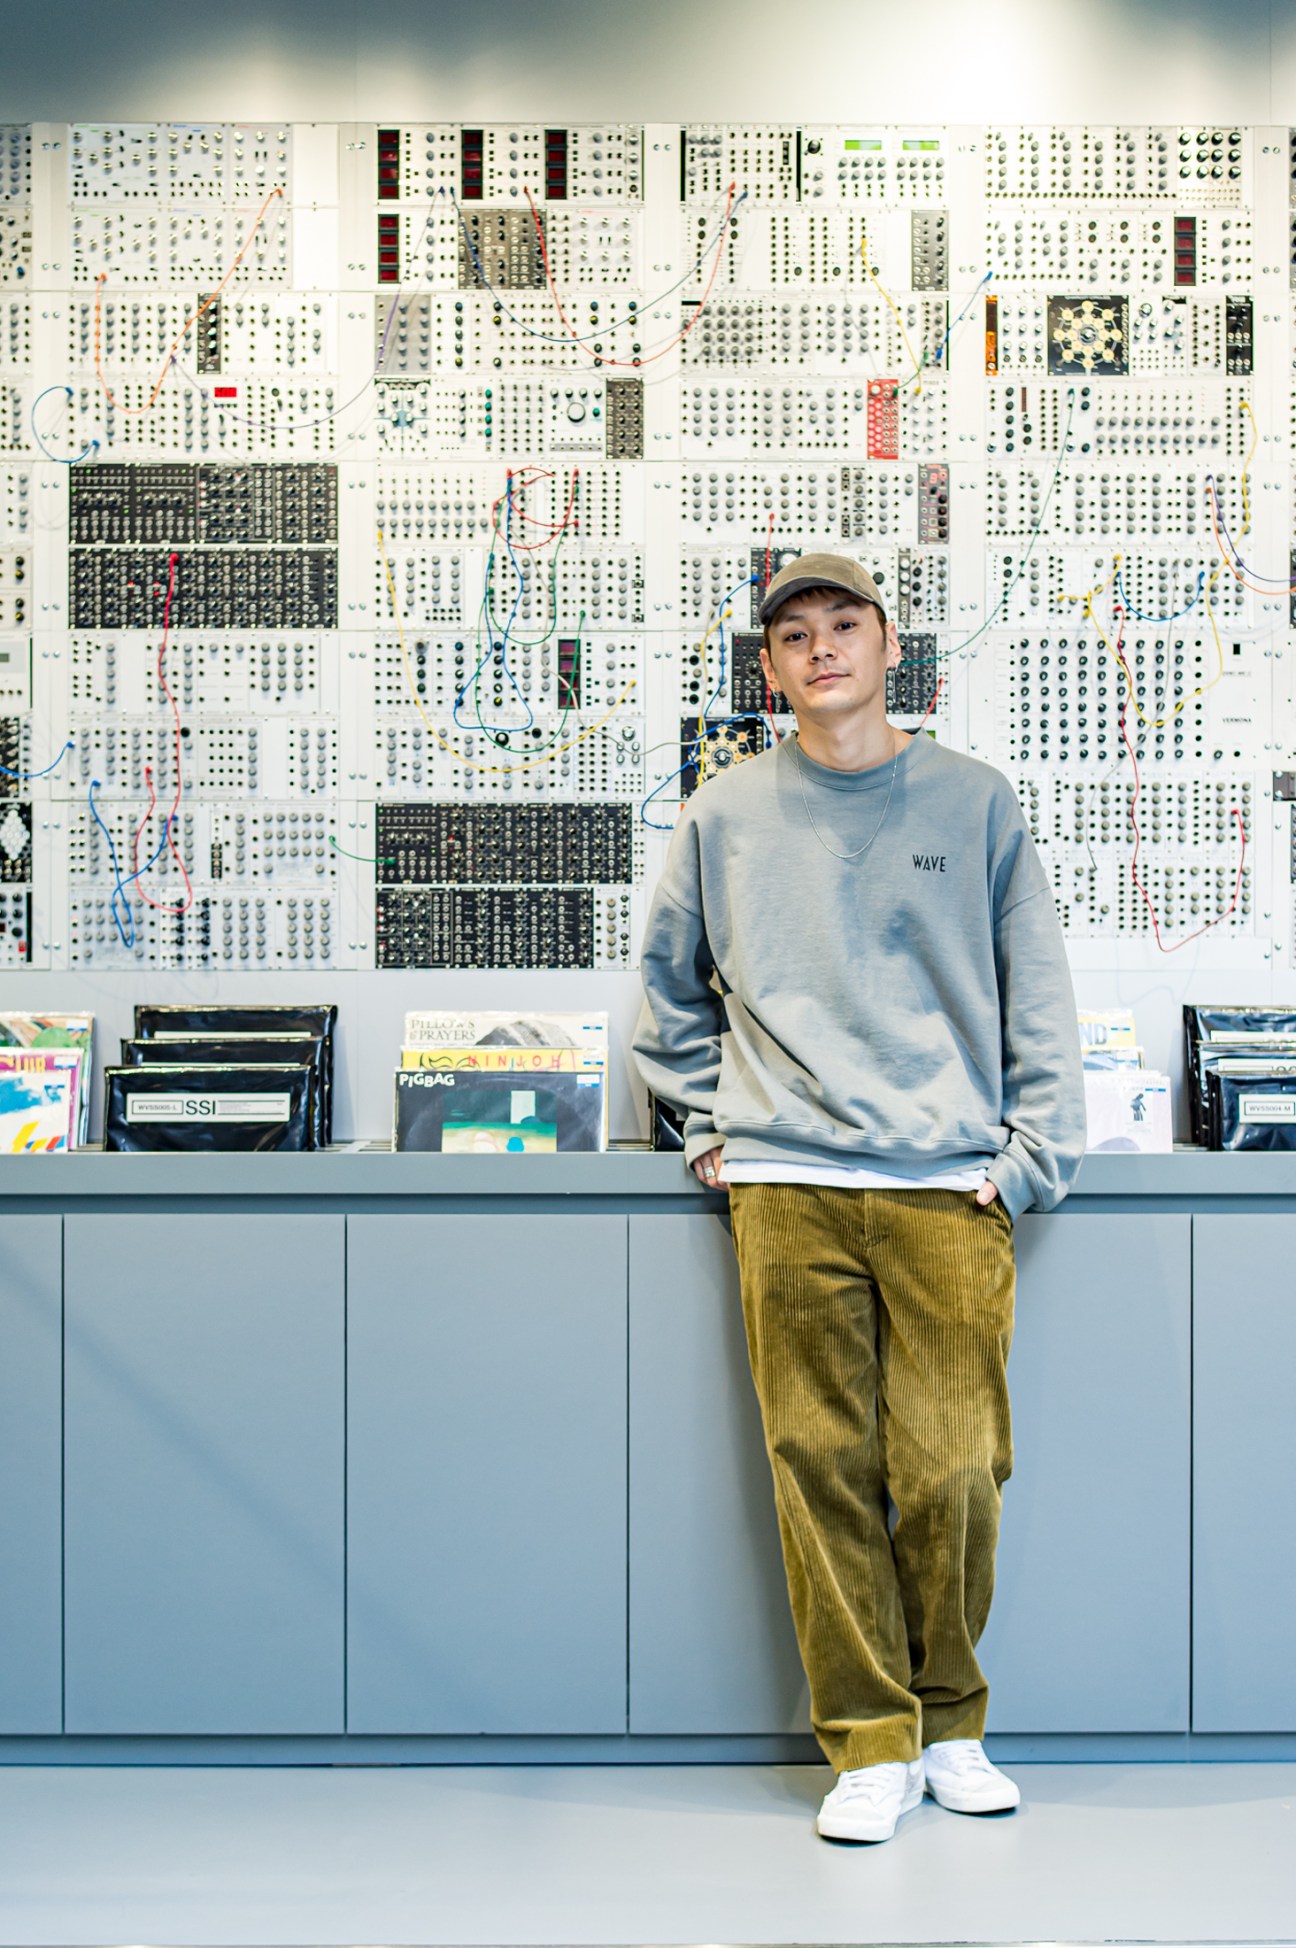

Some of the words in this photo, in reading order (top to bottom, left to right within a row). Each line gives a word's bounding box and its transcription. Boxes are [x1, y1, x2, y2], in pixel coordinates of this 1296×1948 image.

[912, 854, 947, 872] WAVE
[419, 1030, 476, 1041] PRAYERS
[399, 1073, 455, 1089] PIGBAG
[186, 1100, 216, 1115] SSI
